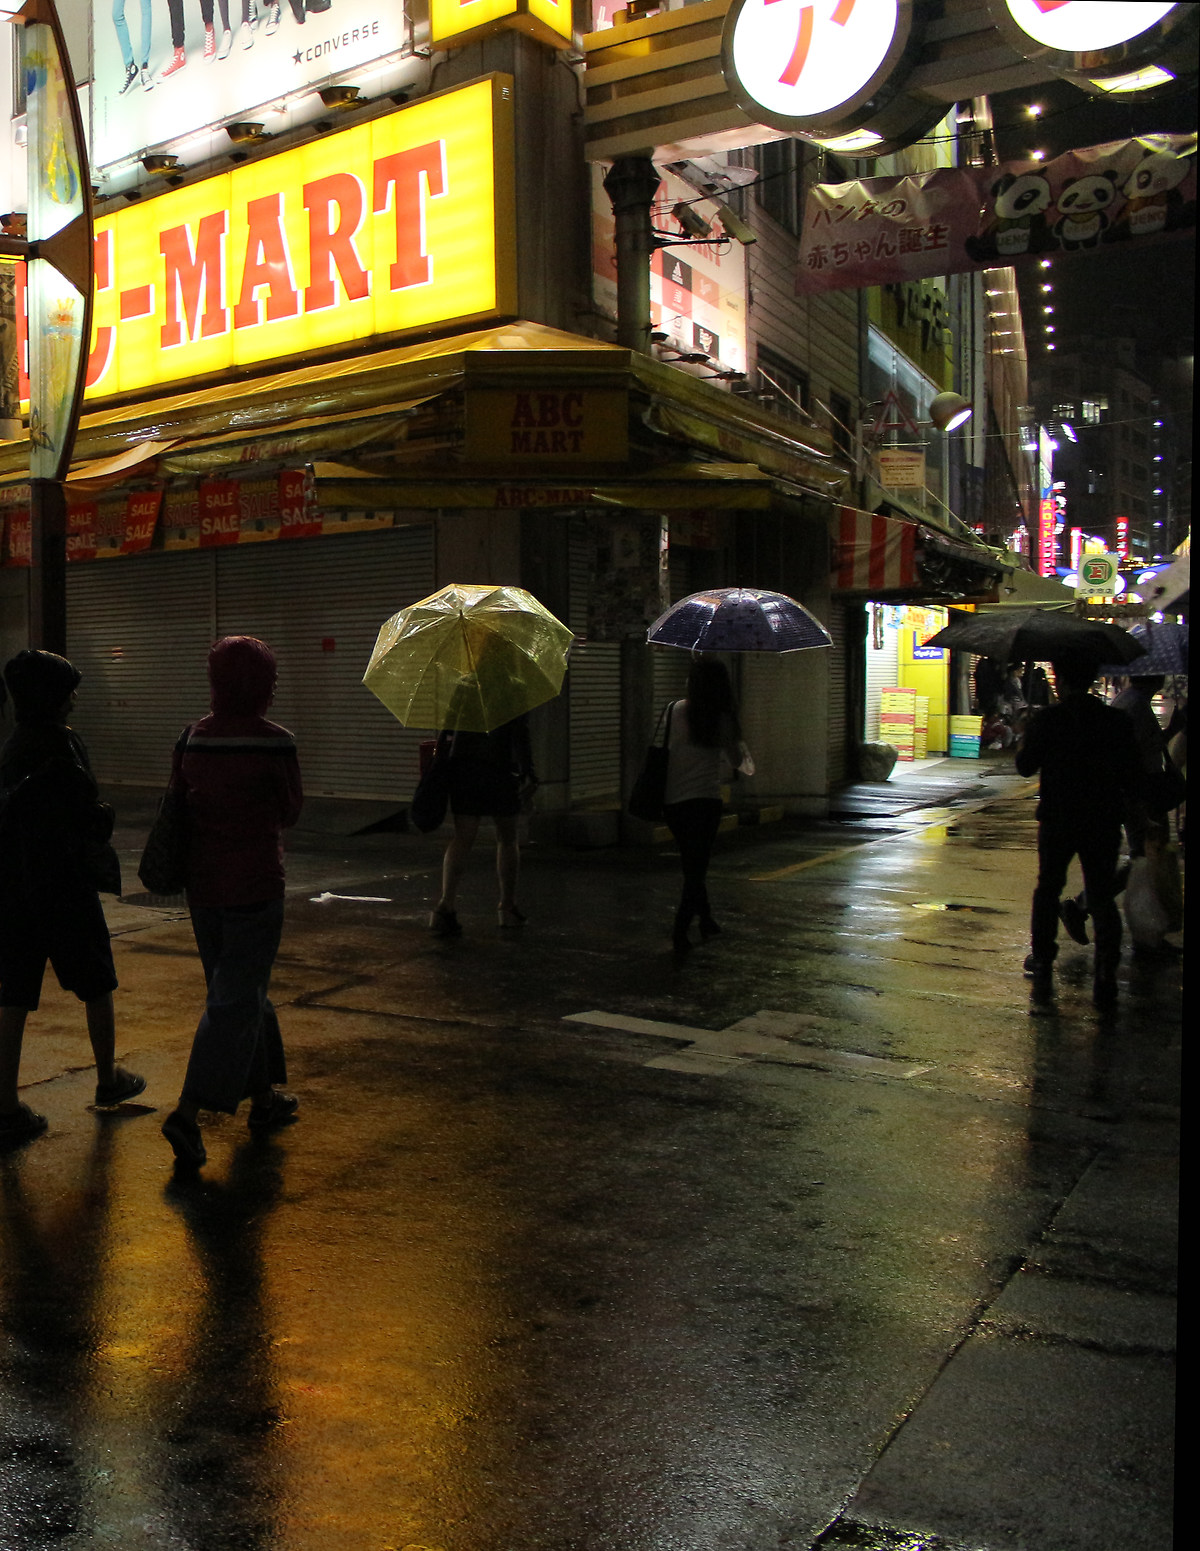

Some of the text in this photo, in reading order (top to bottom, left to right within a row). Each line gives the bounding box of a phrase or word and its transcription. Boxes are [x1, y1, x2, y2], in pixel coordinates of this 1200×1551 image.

[306, 20, 380, 62] CONVERSE
[812, 199, 907, 229] パンダの
[806, 224, 949, 271] 赤ちゃん誕生
[510, 394, 584, 427] ABC
[511, 430, 584, 454] MART
[131, 500, 156, 517] SALE
[206, 492, 233, 508] SALE
[70, 512, 93, 526] SALE
[202, 514, 240, 535] SALE
[67, 534, 98, 549] SALE
[126, 521, 154, 541] SALE
